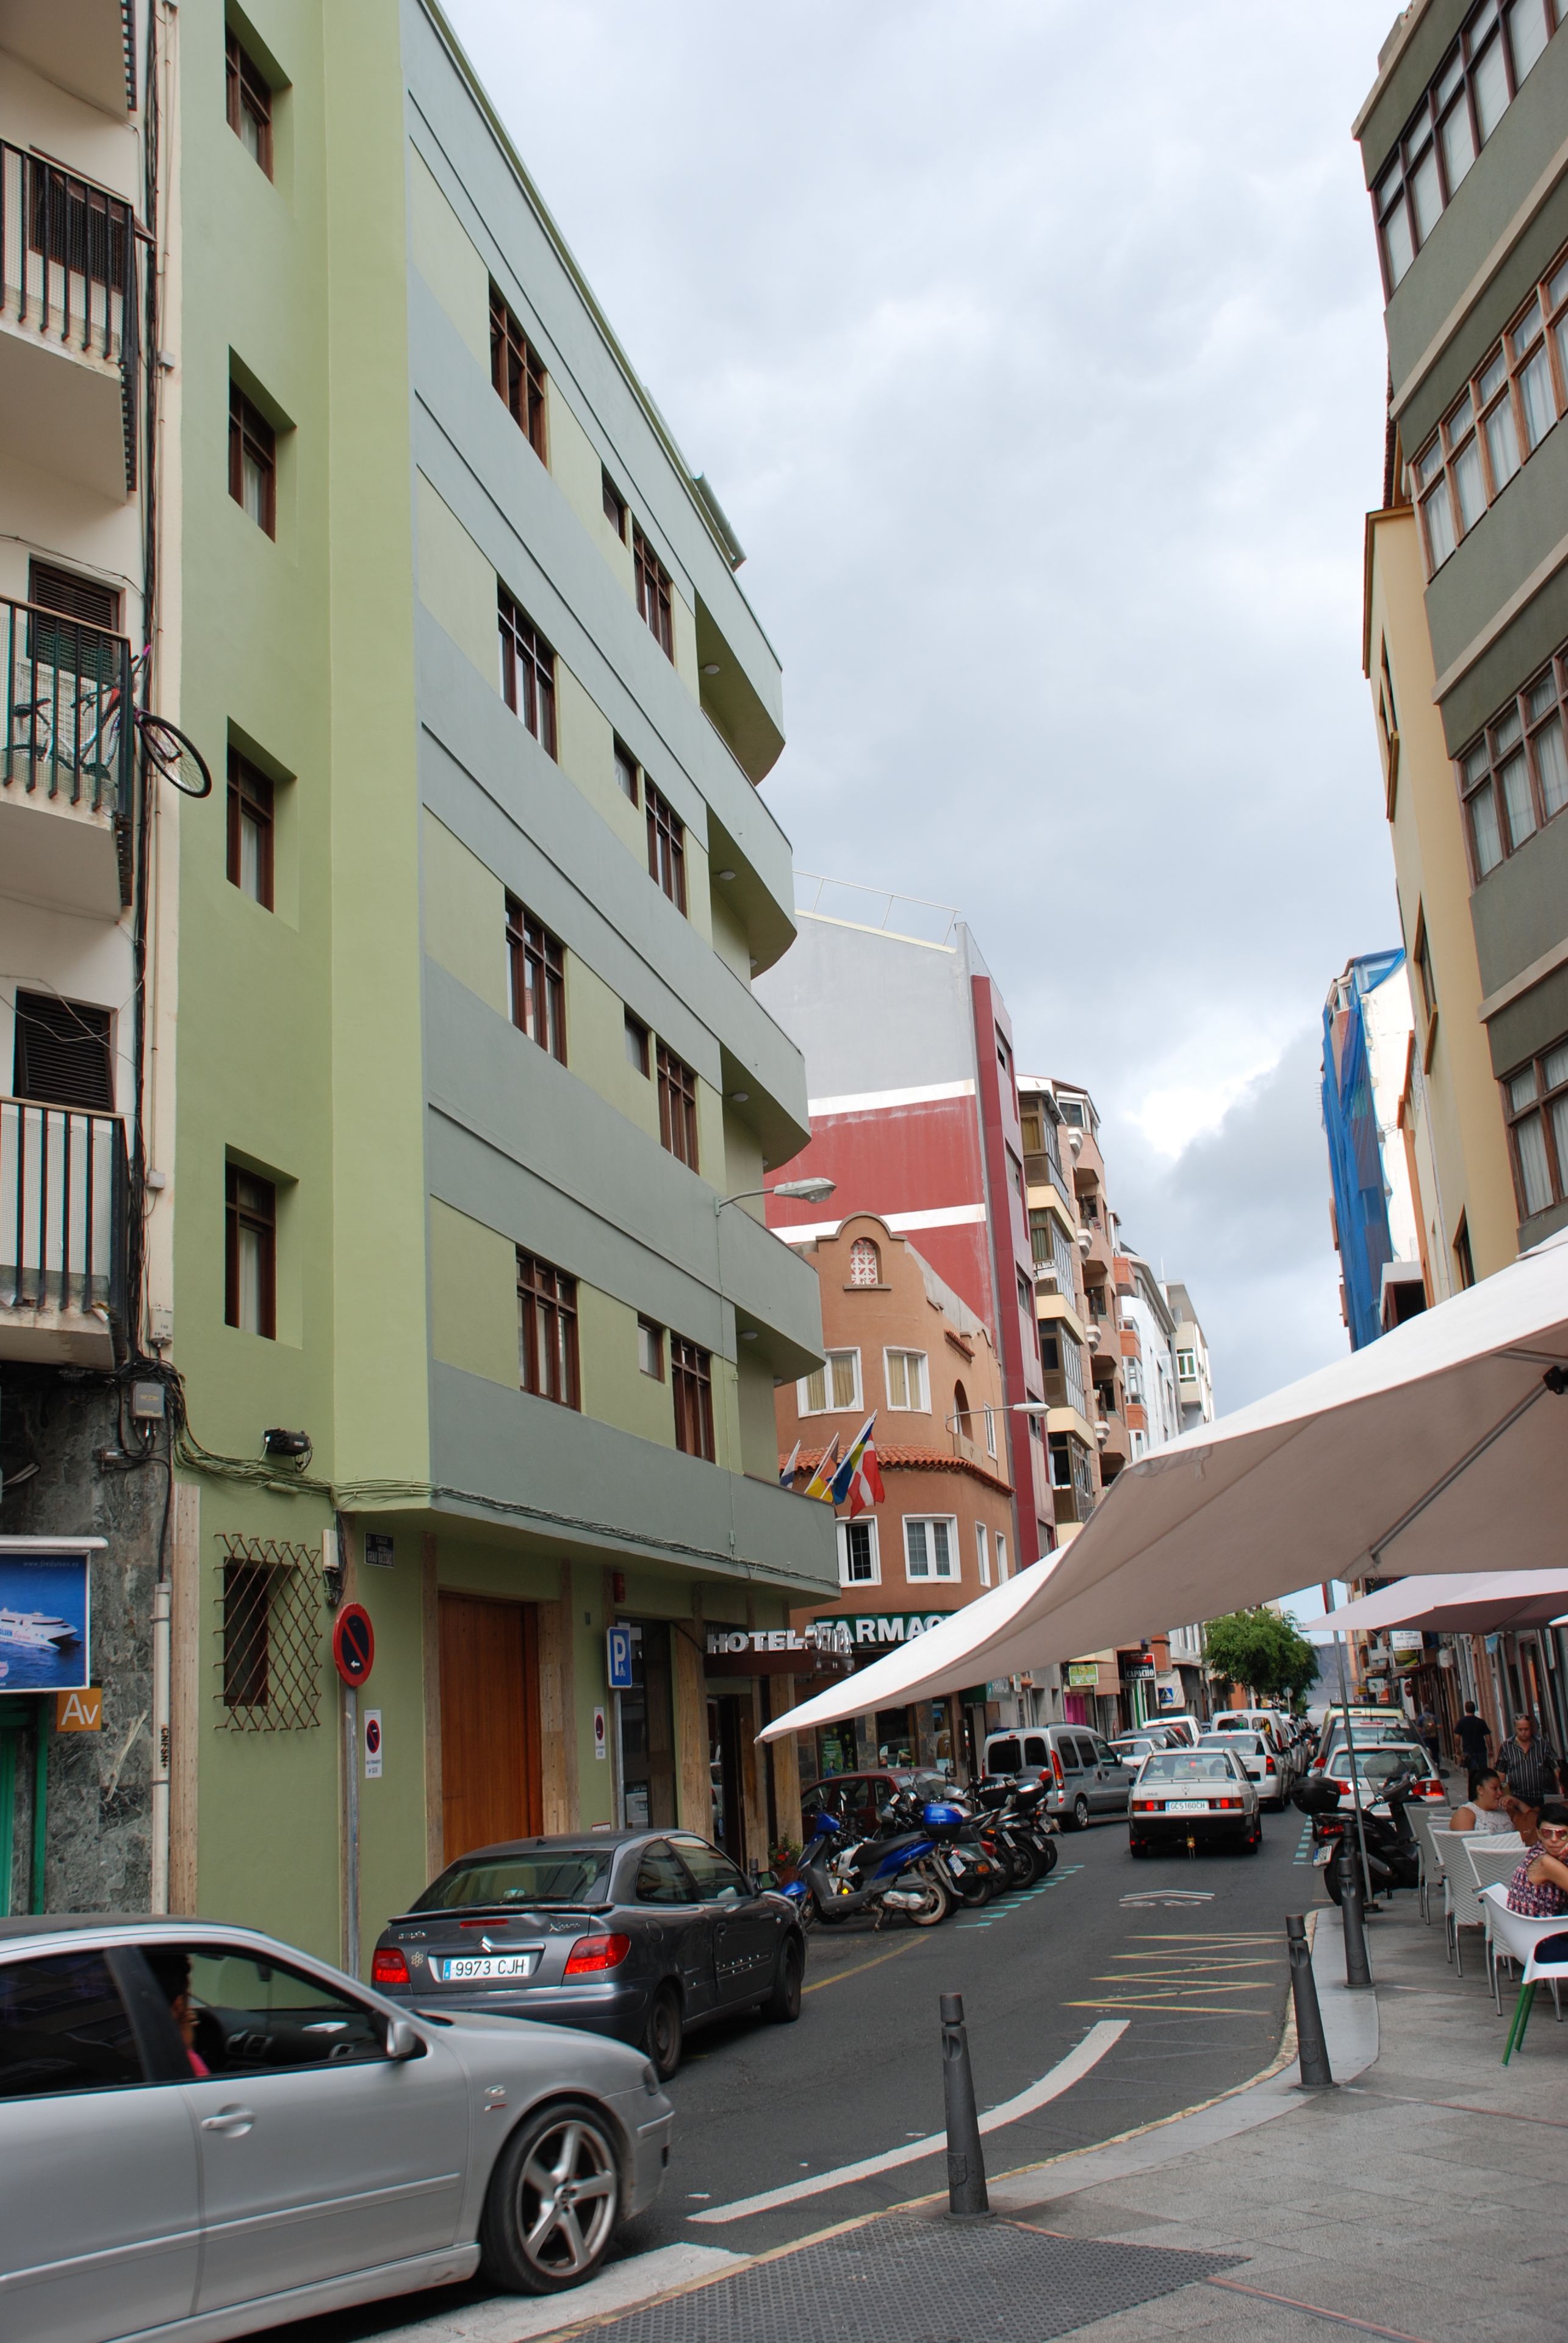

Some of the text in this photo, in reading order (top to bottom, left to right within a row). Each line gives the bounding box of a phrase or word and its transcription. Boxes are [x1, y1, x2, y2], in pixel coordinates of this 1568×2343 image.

[23, 1560, 79, 1569] www.fredolsen.es
[816, 1615, 951, 1643] ARMA
[707, 1630, 805, 1654] HOTEL
[613, 1635, 625, 1676] P
[1127, 1669, 1154, 1678] CAPACHO
[61, 1694, 98, 1726] Av
[456, 1959, 524, 1976] 9973 CJH
